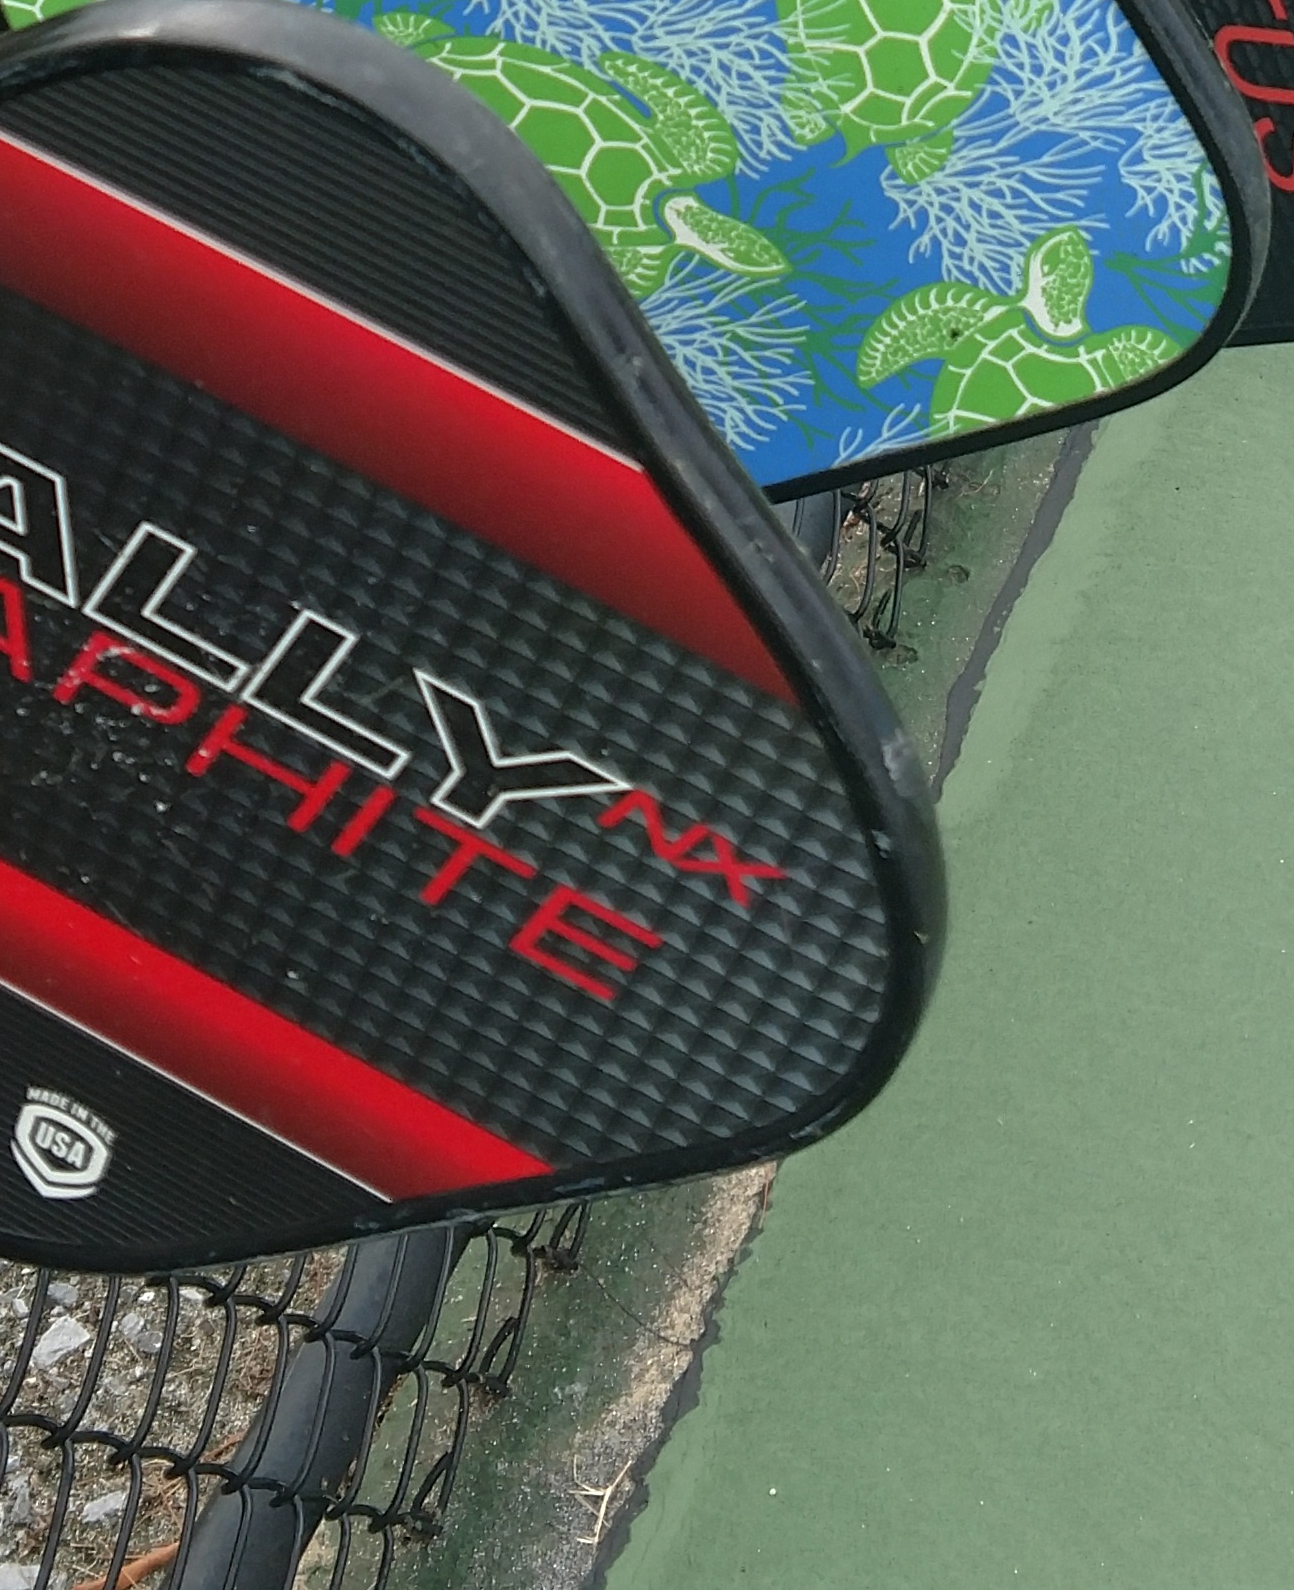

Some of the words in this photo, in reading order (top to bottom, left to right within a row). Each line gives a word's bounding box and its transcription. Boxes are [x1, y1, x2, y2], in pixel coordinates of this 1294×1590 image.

[597, 784, 790, 910] NX
[26, 1087, 69, 1110] MADE
[70, 1102, 89, 1121] IN
[90, 1115, 117, 1146] THE
[35, 1121, 86, 1170] USA
